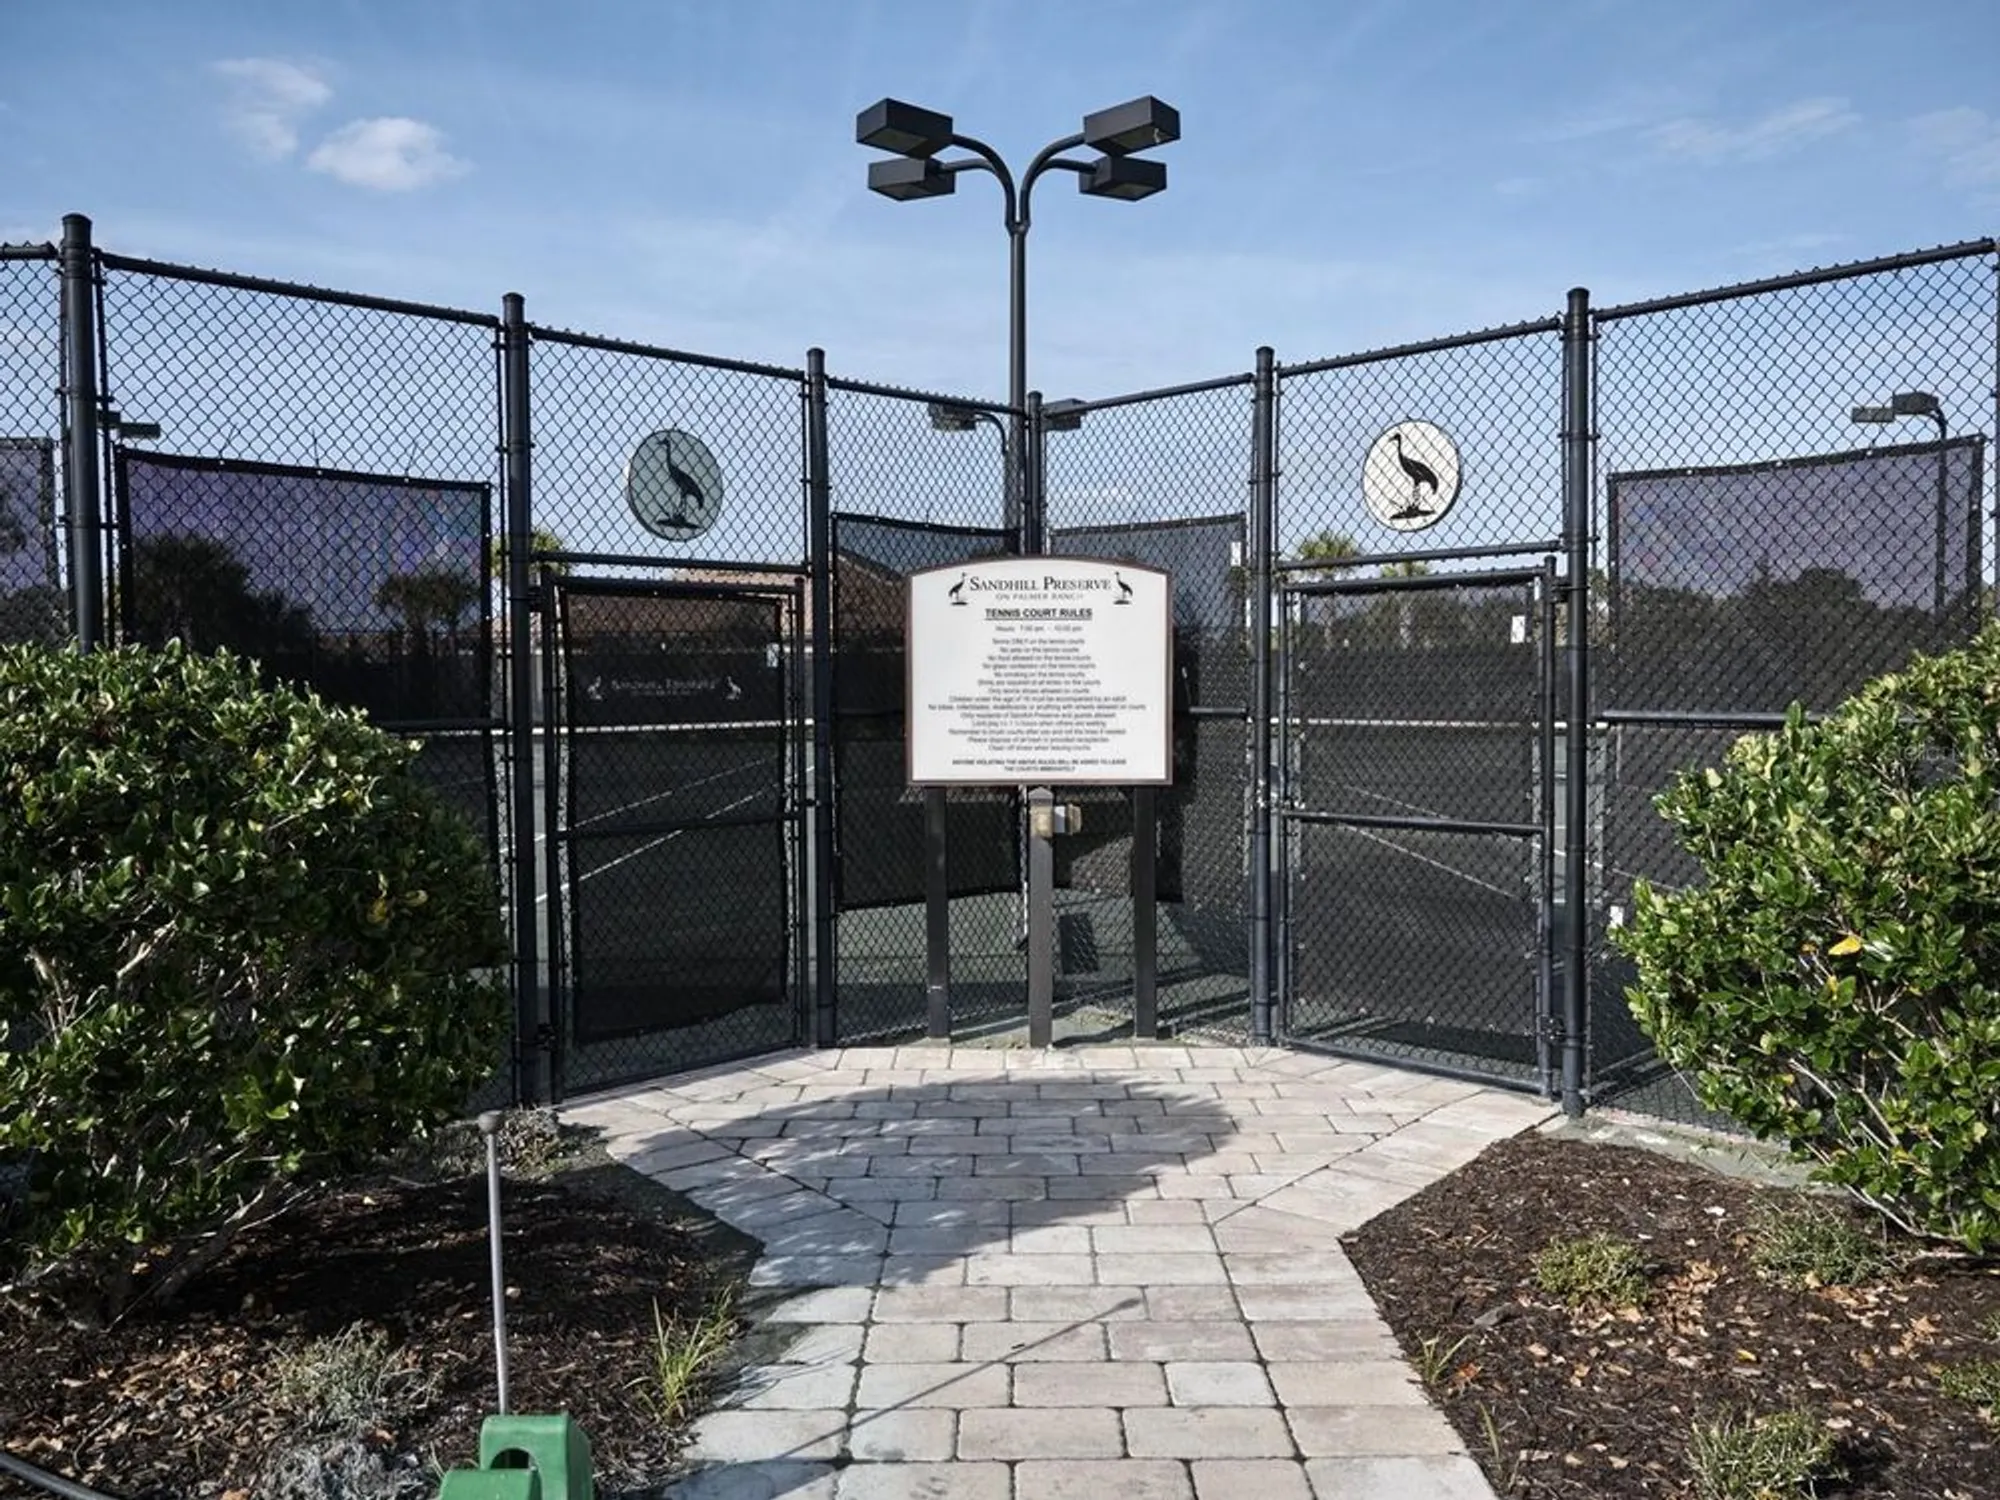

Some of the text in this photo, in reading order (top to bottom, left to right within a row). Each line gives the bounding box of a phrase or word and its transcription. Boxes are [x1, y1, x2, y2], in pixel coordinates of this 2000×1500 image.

[970, 575, 1111, 591] SANDHILL PRESERVE
[995, 592, 1084, 601] ON PALMER RANCH
[985, 607, 1093, 618] TENNIS COURT RULES
